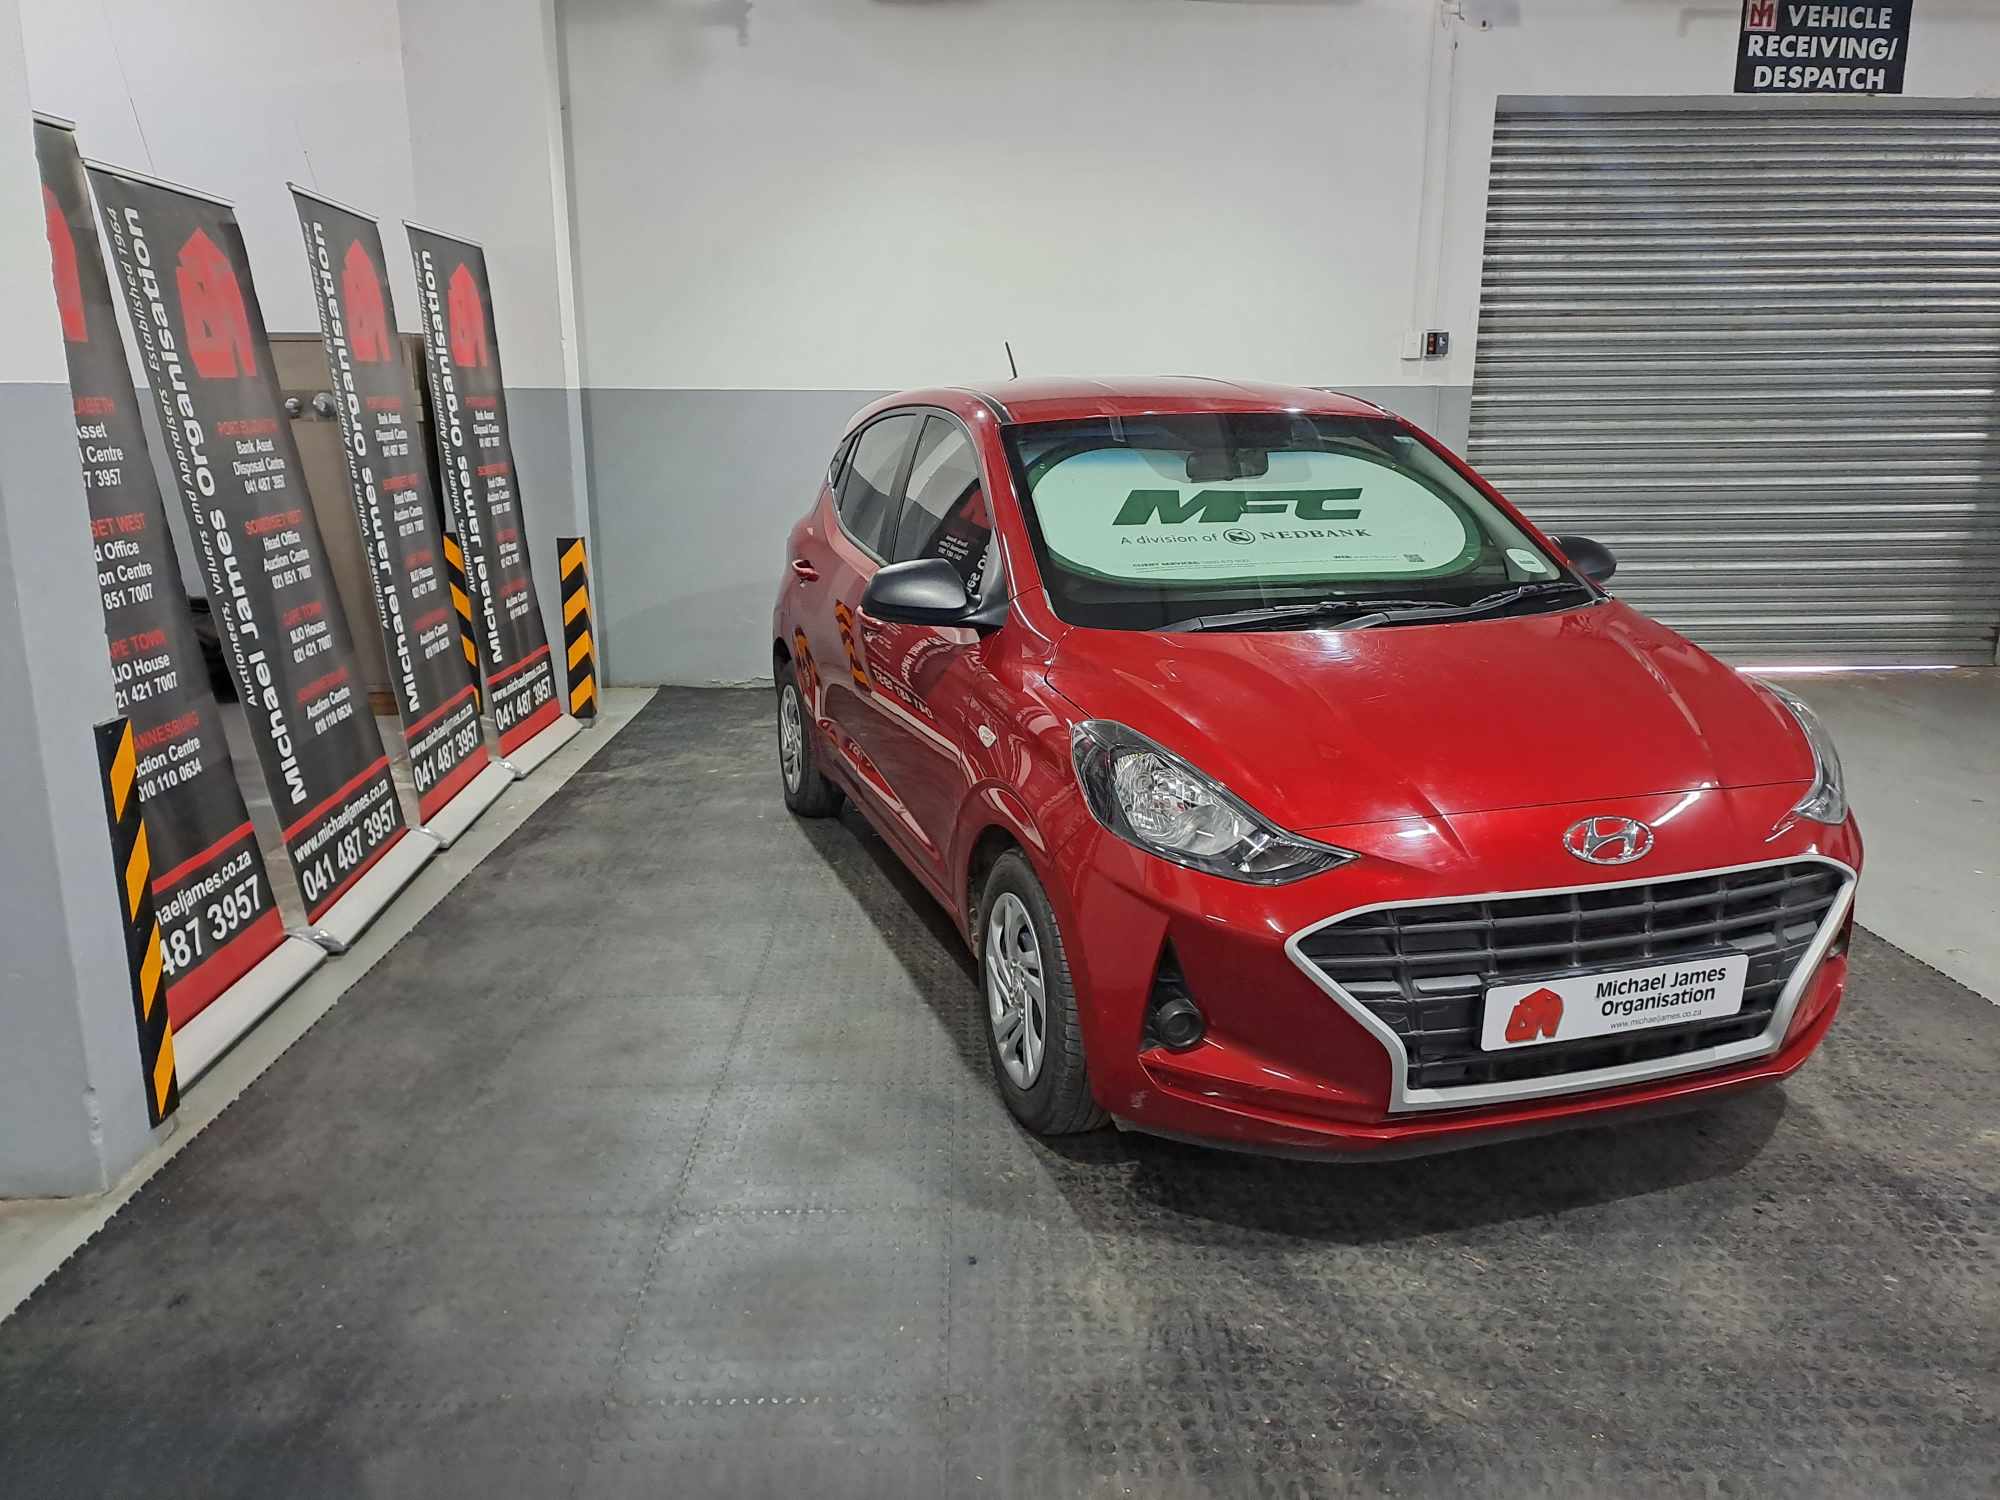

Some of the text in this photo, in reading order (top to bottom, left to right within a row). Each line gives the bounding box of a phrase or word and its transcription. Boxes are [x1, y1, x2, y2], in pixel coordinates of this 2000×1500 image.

[1788, 4, 1893, 30] VEHICLE
[1747, 34, 1899, 61] RECEIVING/
[1753, 65, 1886, 90] DESPATCH
[124, 207, 216, 497] Organisation
[313, 222, 367, 457] Organisation
[86, 445, 124, 463] Centre
[159, 388, 194, 486] Appraisers
[440, 441, 453, 465] and
[345, 450, 359, 479] and
[421, 250, 503, 664] Michael James Organisation
[95, 468, 121, 487] 3957
[185, 490, 204, 525] and
[361, 467, 392, 576] James
[1112, 487, 1363, 526] MFC
[104, 540, 140, 560] Office
[1120, 528, 1372, 546] A division of NEDBANK
[117, 562, 153, 582] Centre
[199, 530, 223, 595] Valuers
[209, 509, 259, 640] James
[104, 583, 153, 610] 851 7007
[133, 654, 170, 677] House
[221, 602, 258, 706] Auctioneers,
[384, 584, 420, 713] Michael
[132, 681, 153, 702] 421
[154, 671, 178, 694] 7007
[495, 676, 552, 731] 041 487 3957
[248, 650, 307, 806] Michael
[168, 737, 201, 761] Centre
[414, 720, 479, 793] 041 487 3957
[157, 770, 178, 796] 110
[294, 778, 389, 863] www.michaeljames.co.za
[302, 798, 398, 902] 041 487 3957
[207, 874, 260, 941] 3957
[1595, 966, 1727, 999] Michael James
[1601, 986, 1716, 1018] Organisation
